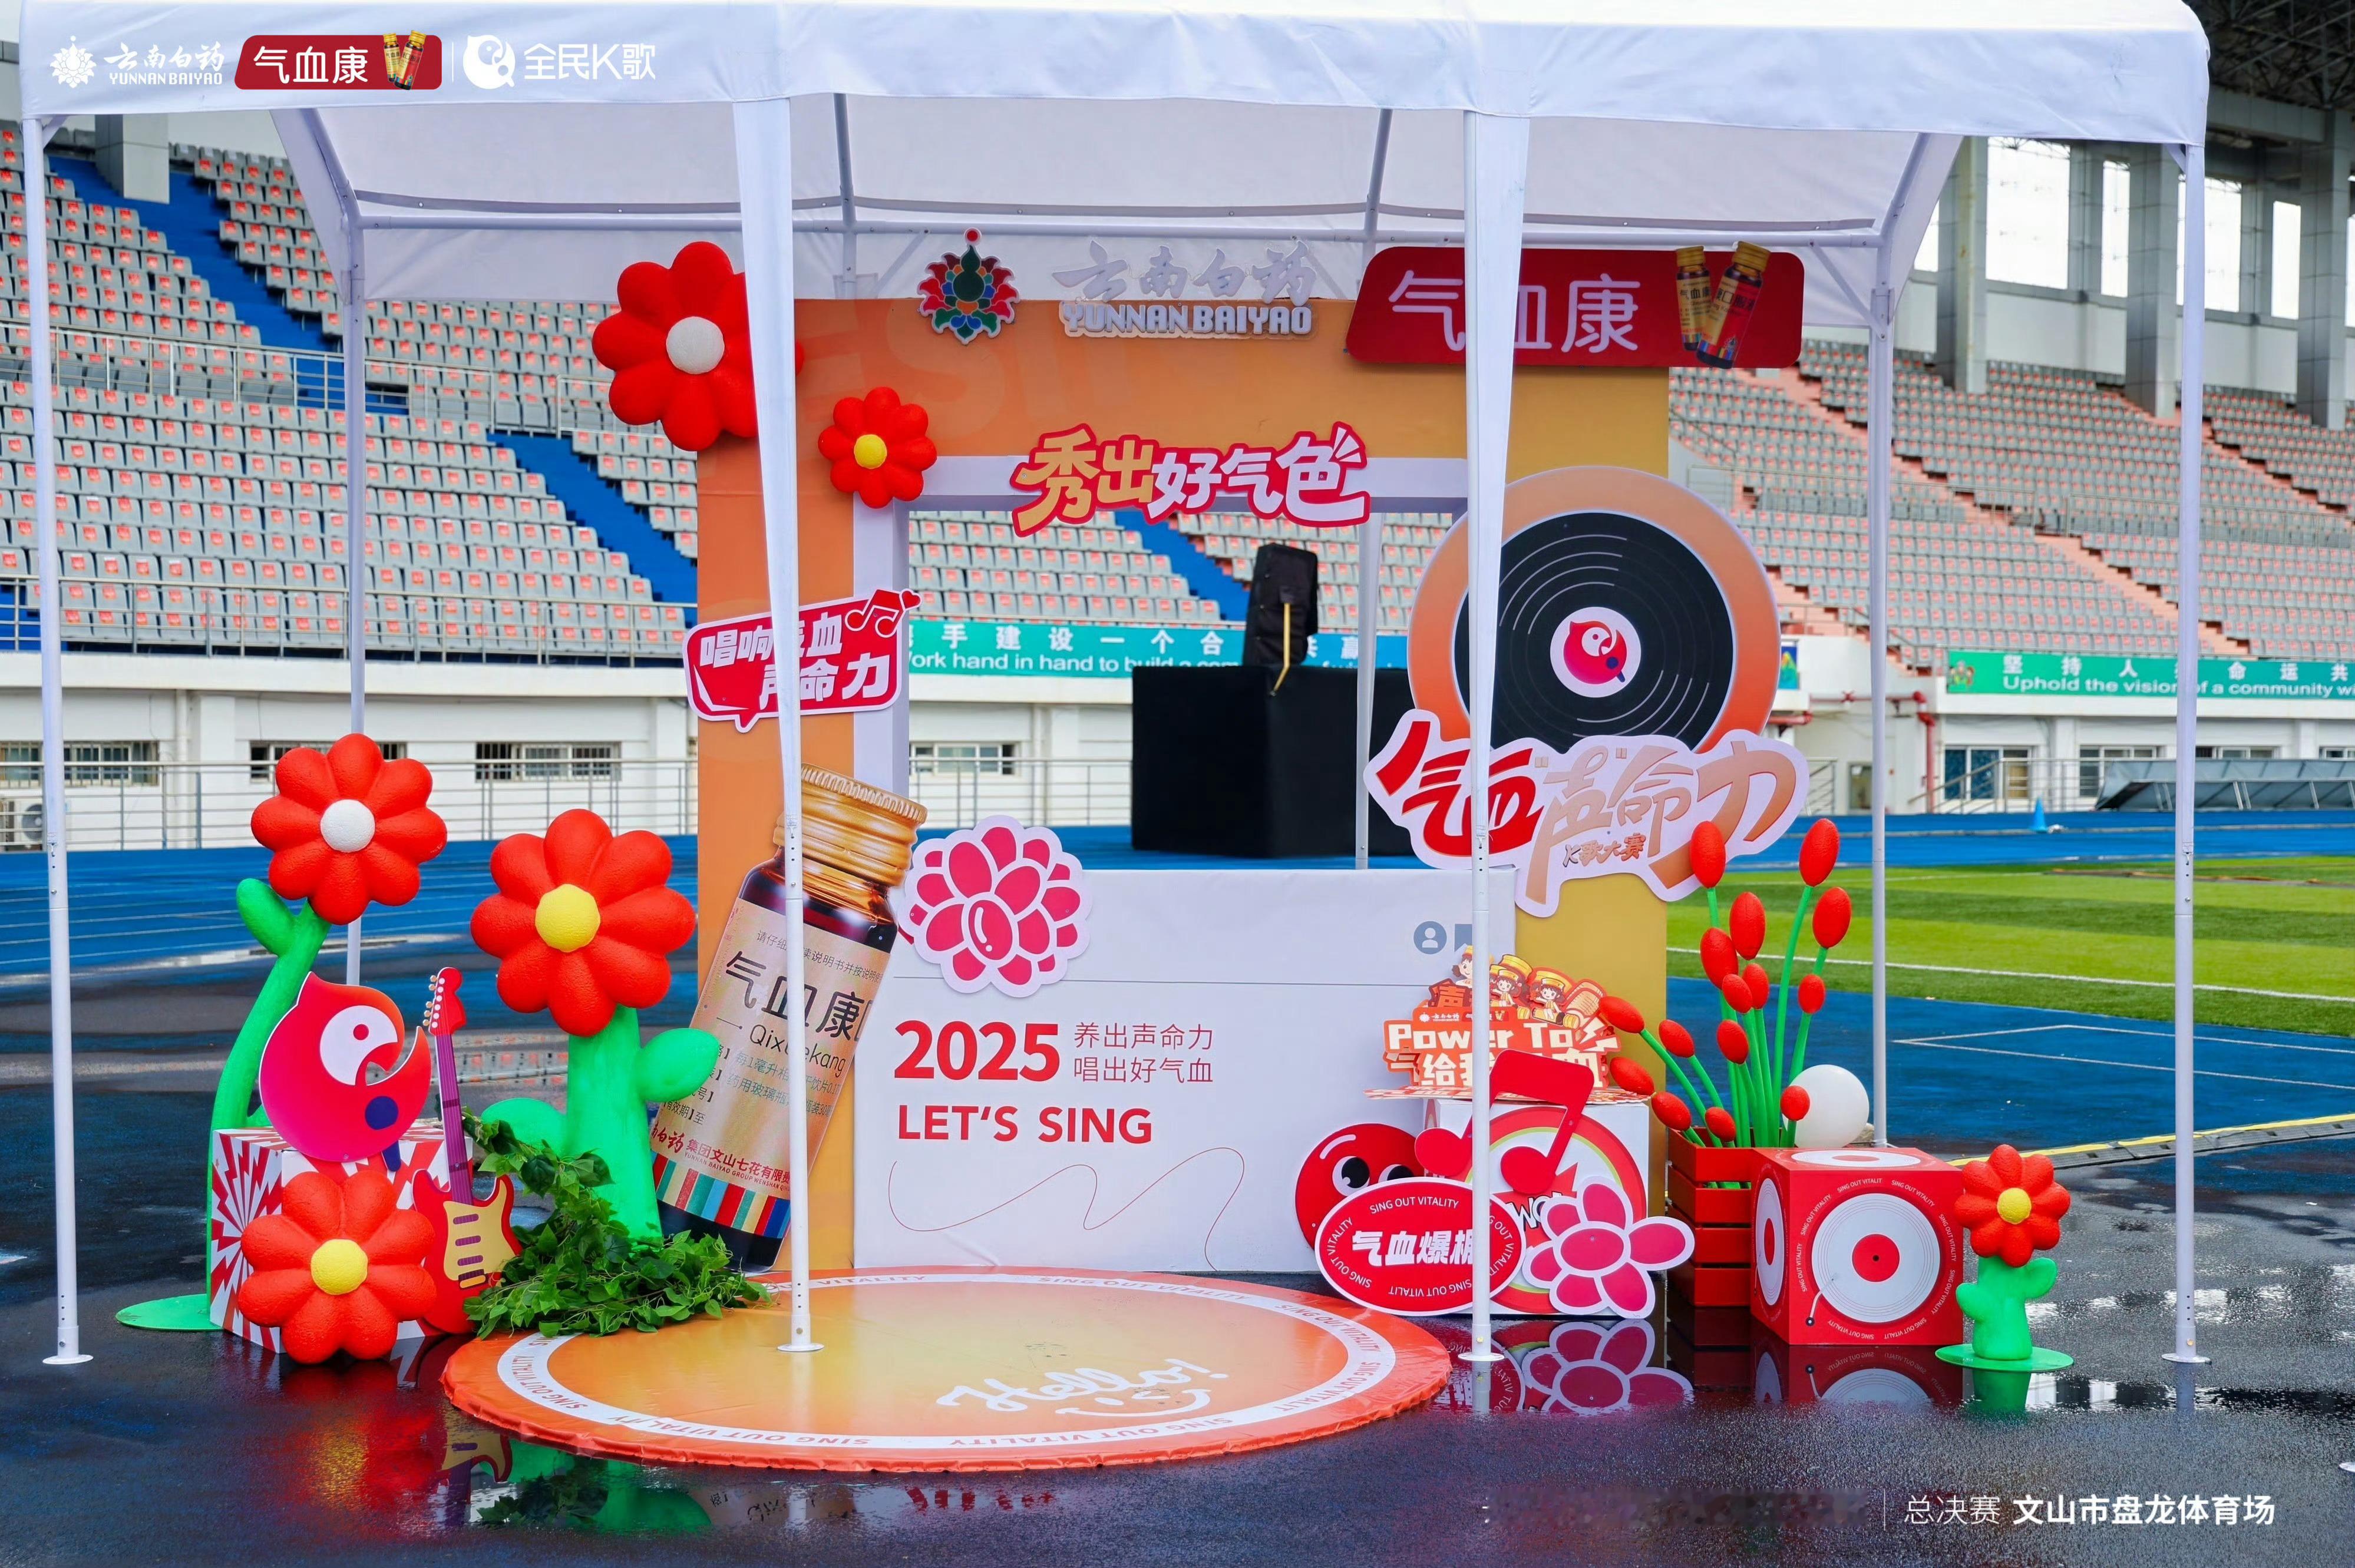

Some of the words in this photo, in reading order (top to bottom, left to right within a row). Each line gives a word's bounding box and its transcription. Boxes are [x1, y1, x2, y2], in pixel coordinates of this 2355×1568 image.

[1053, 240, 1317, 306] 云南白药
[1063, 303, 1189, 333] YUNNAN
[1193, 305, 1312, 334] BAIYAO
[1015, 427, 1367, 532] 秀出好气色
[699, 611, 842, 669] 唱响血
[953, 652, 1009, 670] hand
[1015, 654, 1033, 670] in
[1039, 654, 1094, 672] hand
[1099, 657, 1119, 672] to
[2003, 654, 2349, 682] 坚持人命运共
[2003, 676, 2080, 692] Uphold
[2085, 679, 2118, 693] the
[2212, 683, 2224, 694] a
[2229, 682, 2333, 698] community
[1563, 832, 1647, 868] K歌大赛
[757, 930, 884, 983] 请仔细读说明书并按说明使
[1074, 1021, 1214, 1051] 养出声命力
[1523, 1023, 1573, 1048] To
[894, 1019, 1061, 1083] 2025
[1074, 1056, 1214, 1084] 唱出好气血
[1038, 1106, 1152, 1144] SING
[684, 1152, 708, 1165] YUNNAN
[708, 1160, 731, 1174] BAIYAO
[732, 1169, 753, 1181] GROUP
[754, 1177, 780, 1189] WENSHAN
[1837, 1183, 1850, 1193] SING
[1891, 1180, 1904, 1189] SING
[1904, 1184, 1916, 1193] OUT
[1369, 1202, 1393, 1215] SING
[1395, 1196, 1415, 1208] OUT
[1418, 1196, 1459, 1209] VITALITY
[1494, 1220, 1512, 1242] OUT
[1801, 1221, 1809, 1235] SING
[1807, 1211, 1816, 1222] OUT
[1938, 1214, 1948, 1227] SING
[1945, 1226, 1953, 1238] OUT
[1327, 1217, 1353, 1256] VITALITY
[1329, 1256, 1349, 1275] OUT
[817, 1275, 927, 1285] VITALITY
[1349, 1271, 1372, 1289] SING
[1798, 1278, 1808, 1292] SING
[1947, 1269, 1956, 1283] SING
[1103, 1280, 1152, 1289] OUT
[1159, 1285, 1250, 1301] VITALITY
[1426, 1286, 1448, 1297] OUT
[1448, 1279, 1472, 1294] SING
[1943, 1283, 1953, 1295] OUT
[1274, 1304, 1320, 1316] SING
[1314, 1316, 1350, 1327] OUT
[1340, 1327, 1381, 1352] VITALITY
[1903, 1325, 1915, 1334] OUT
[1914, 1317, 1927, 1328] SING
[511, 1355, 537, 1381] VITALITY
[1353, 1361, 1381, 1377] SING
[520, 1381, 553, 1394] OUT
[936, 1358, 1230, 1412] Hello!
[1334, 1377, 1368, 1390] OUT
[541, 1394, 588, 1409] SING
[607, 1415, 719, 1436] VITALITY
[1101, 1427, 1160, 1440] OUT
[1165, 1417, 1234, 1431] SING
[722, 1431, 787, 1441] OUT
[796, 1436, 872, 1445] SING
[949, 1433, 1091, 1447] VITALITY
